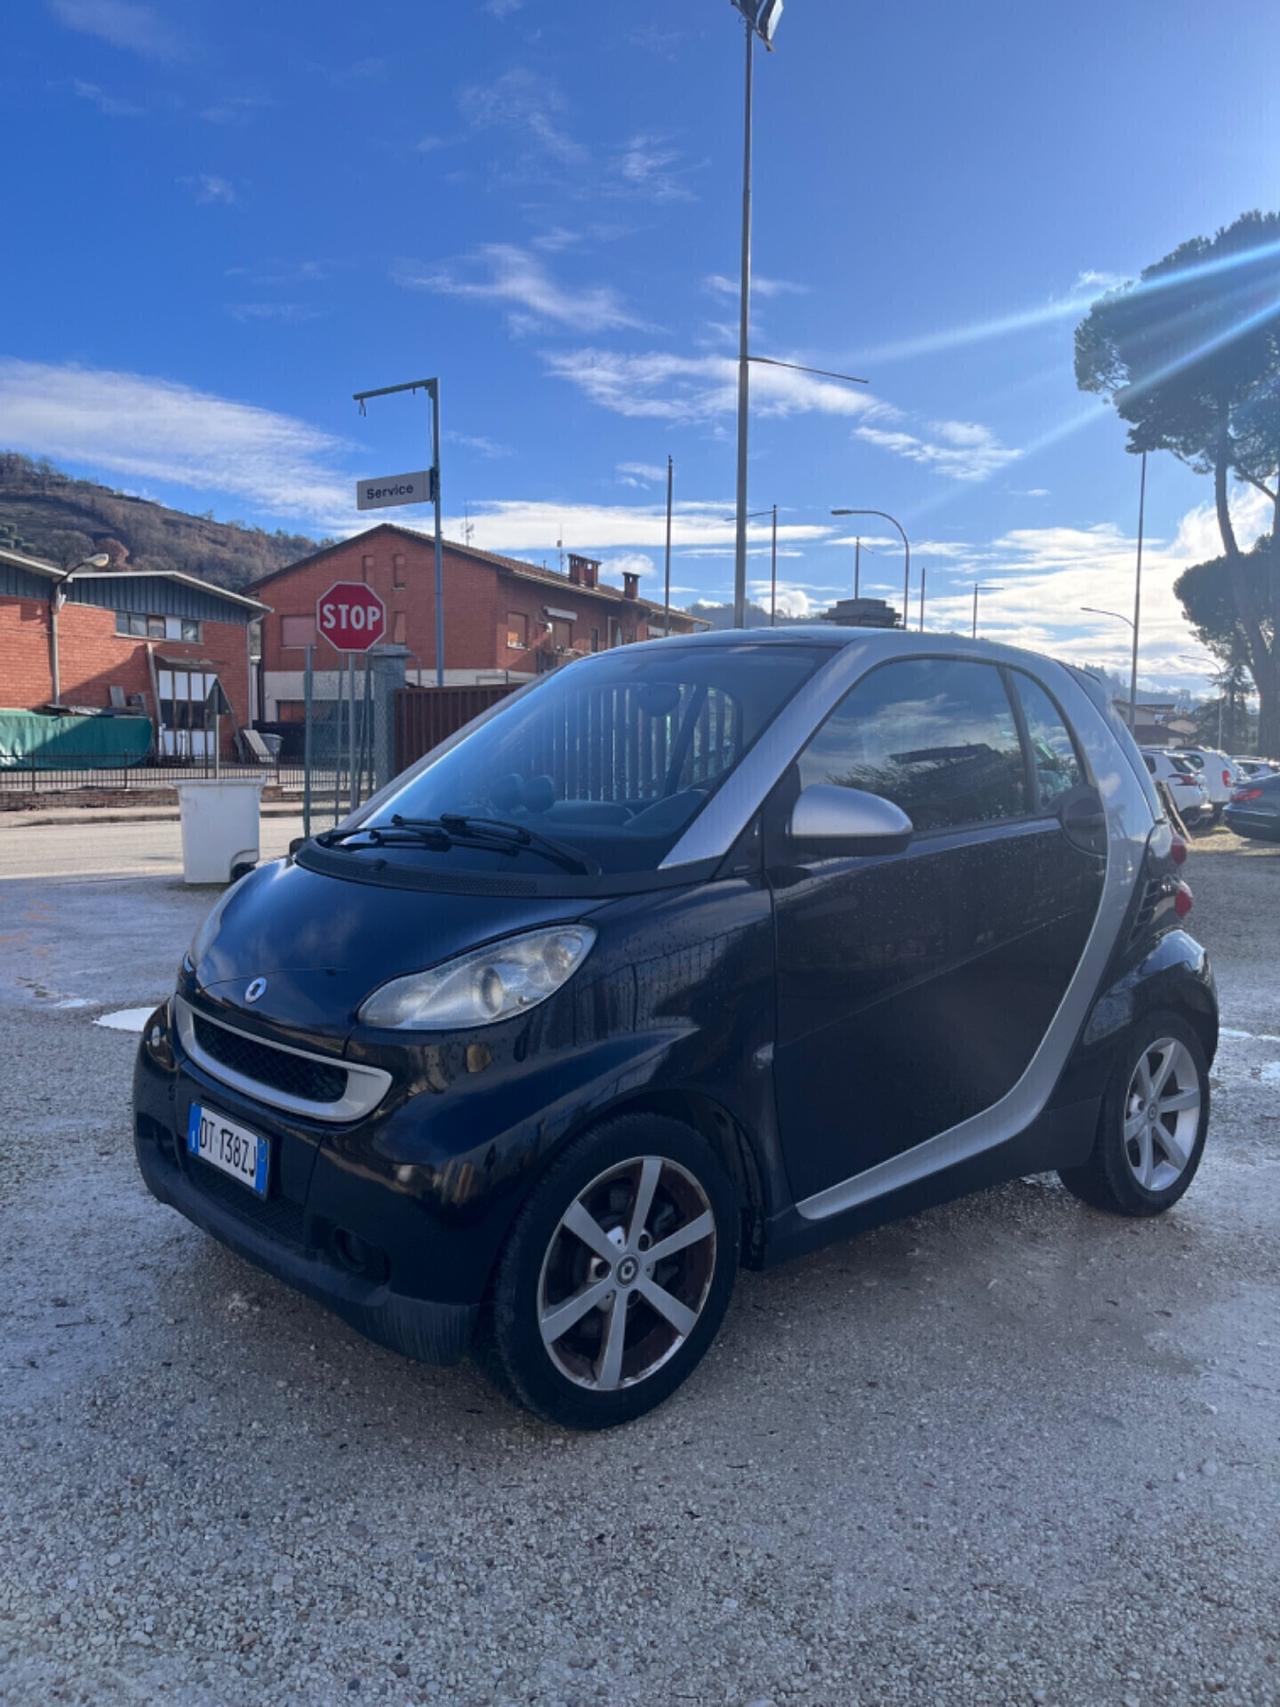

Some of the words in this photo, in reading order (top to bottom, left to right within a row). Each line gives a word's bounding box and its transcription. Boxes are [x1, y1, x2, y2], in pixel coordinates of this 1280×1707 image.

[367, 484, 414, 499] Service
[322, 604, 381, 631] STOP
[200, 1117, 215, 1153] DT
